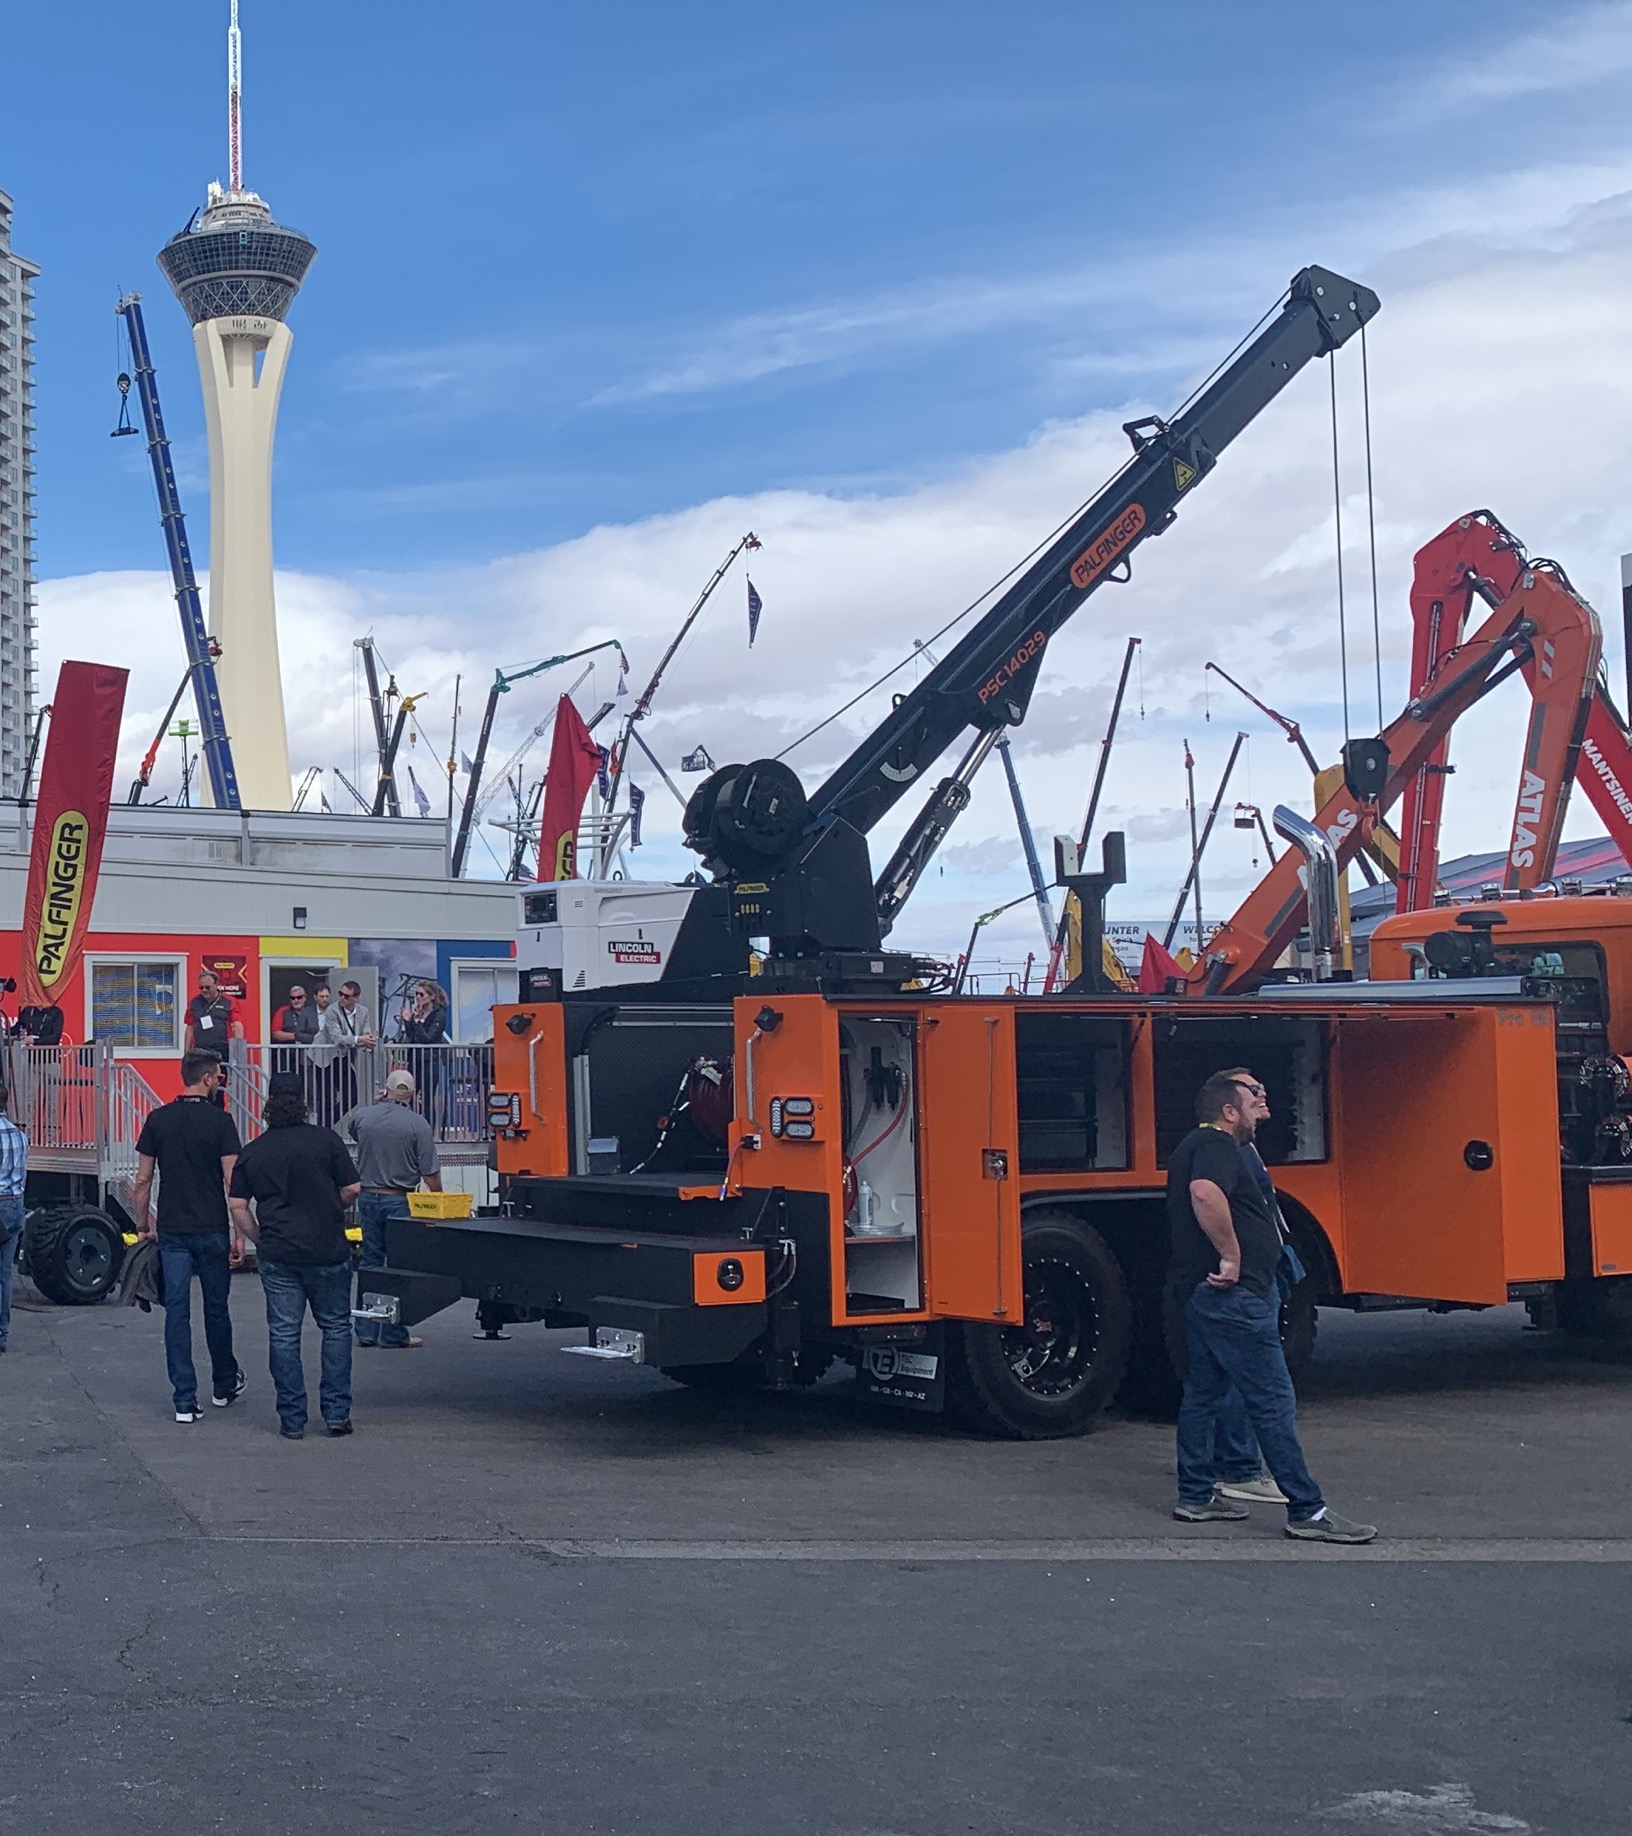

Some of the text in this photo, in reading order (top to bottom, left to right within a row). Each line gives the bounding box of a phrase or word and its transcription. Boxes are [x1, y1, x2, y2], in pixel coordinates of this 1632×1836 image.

[1074, 509, 1142, 583] PALFINGER
[1511, 769, 1546, 868] ATLAS
[38, 822, 84, 975] PALFINGER
[610, 943, 652, 954] LINCOLN
[1104, 925, 1140, 935] UNTER
[620, 953, 657, 963] ELECTRIC
